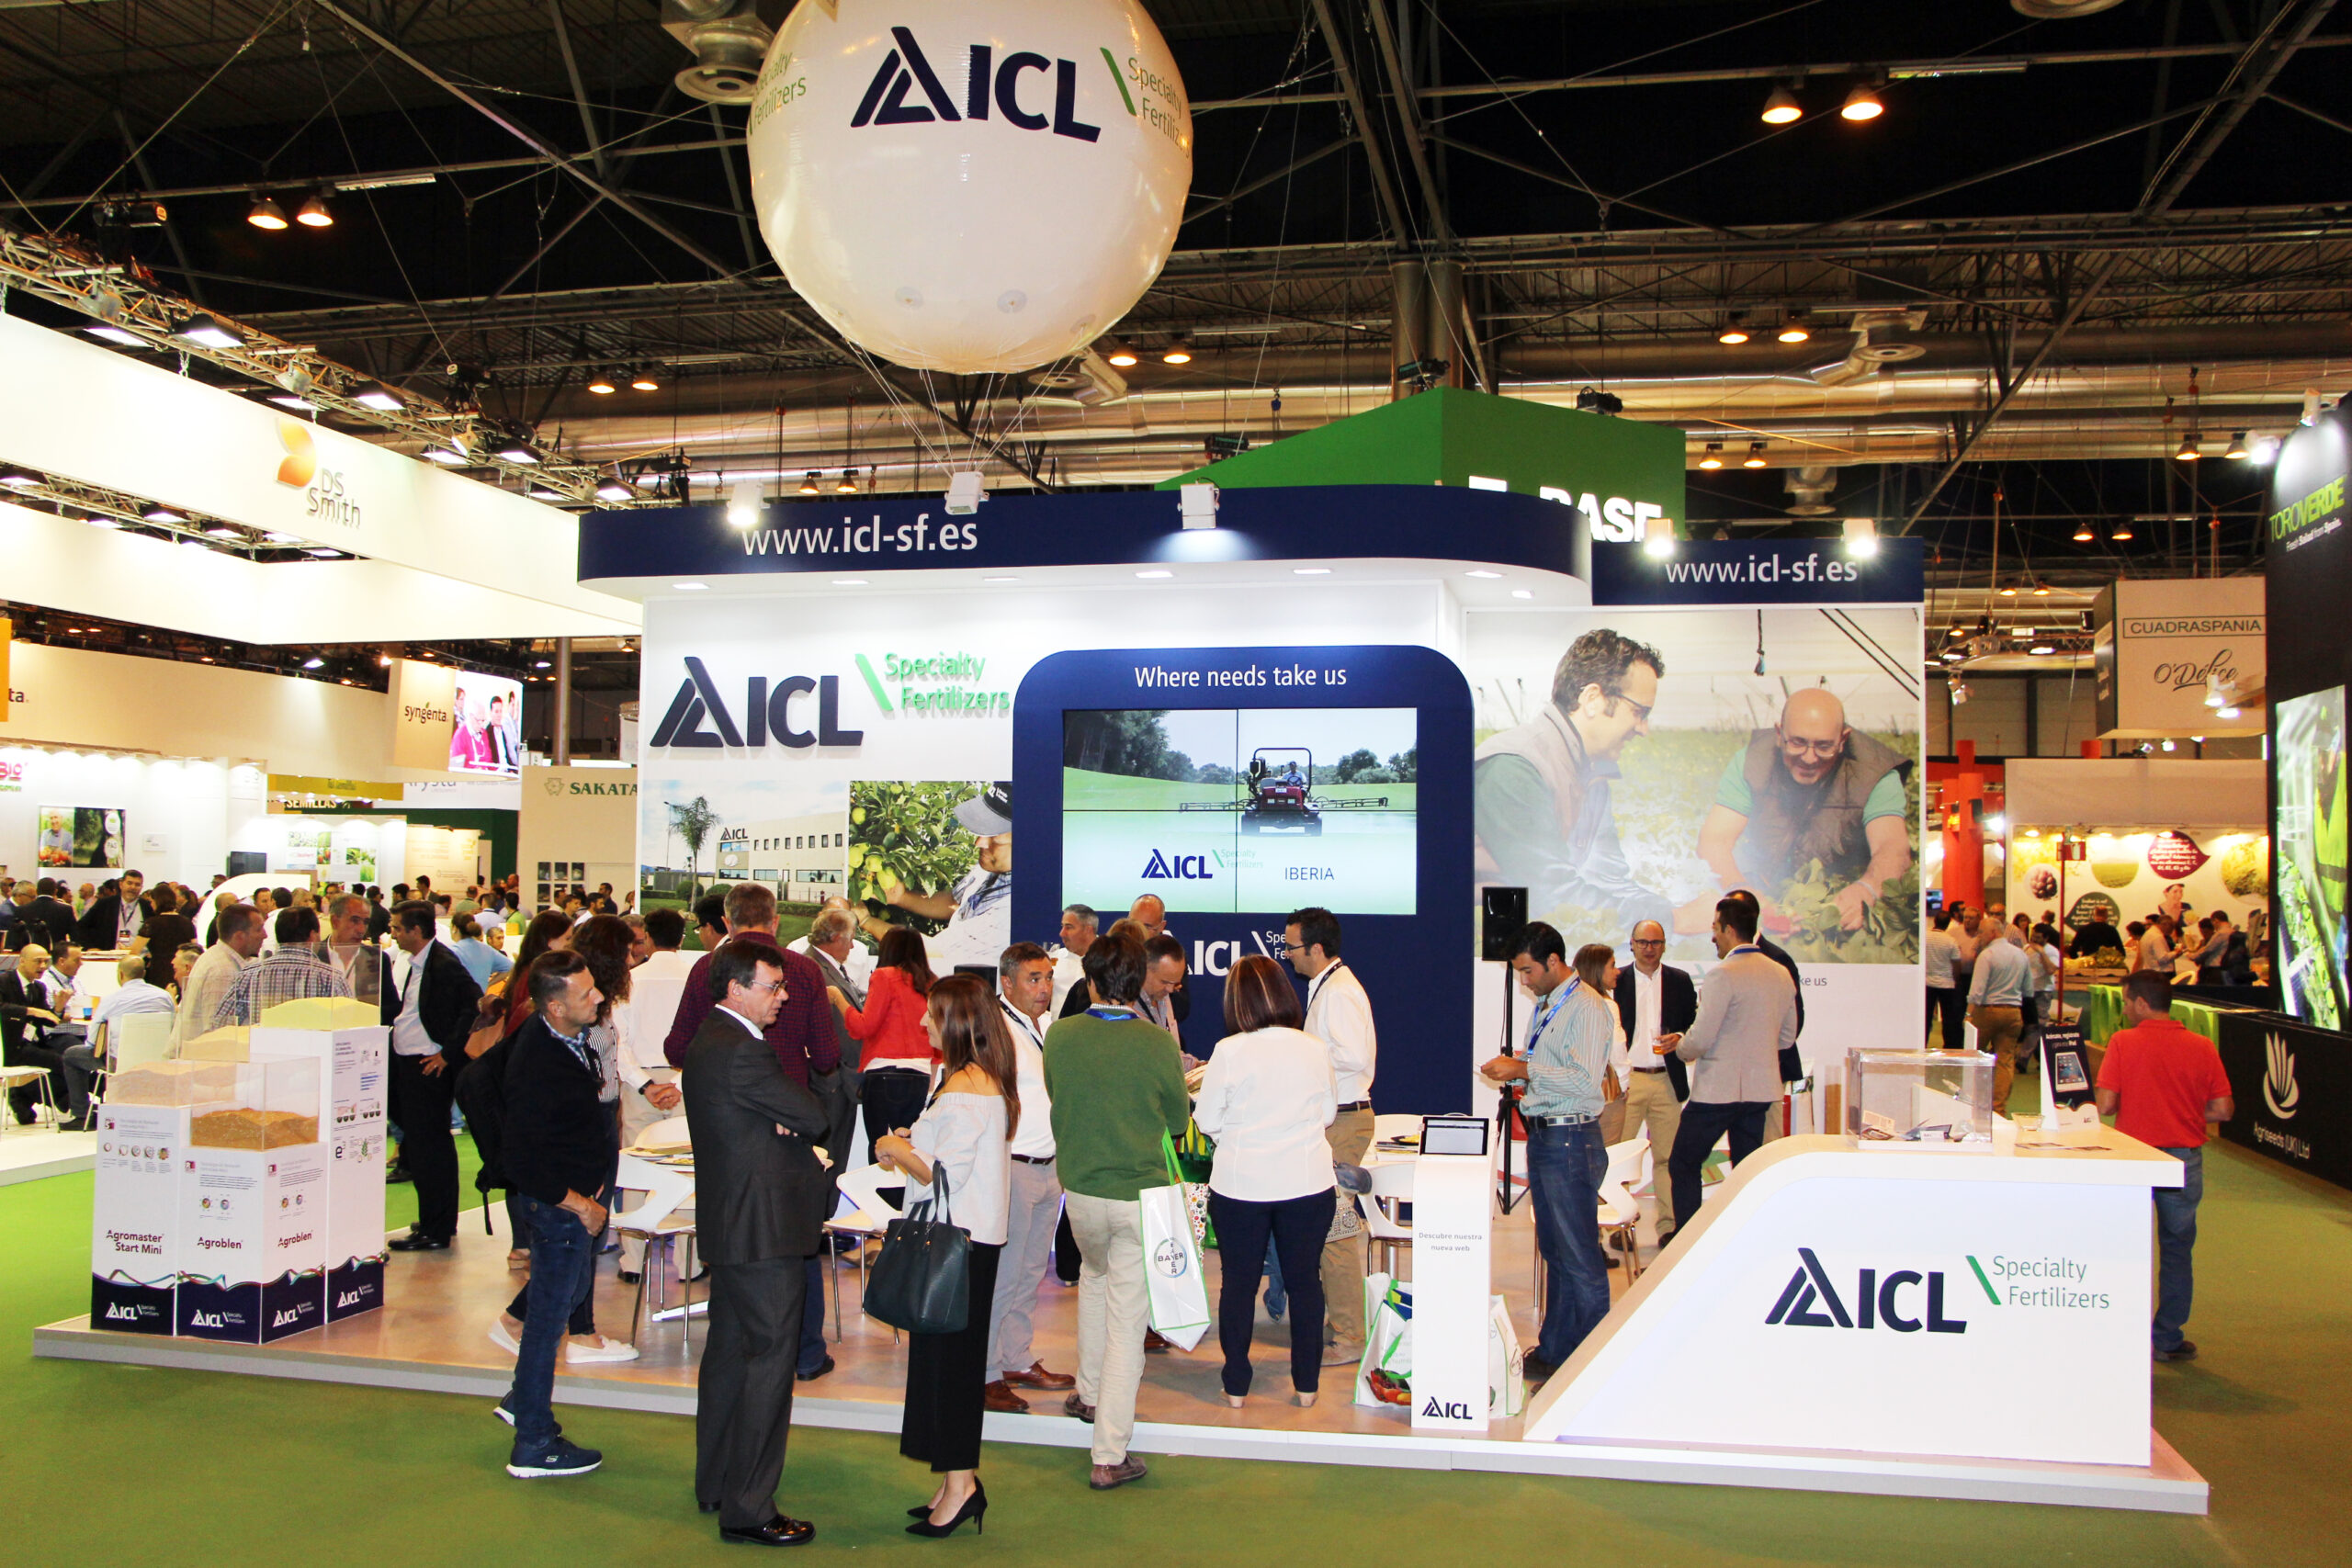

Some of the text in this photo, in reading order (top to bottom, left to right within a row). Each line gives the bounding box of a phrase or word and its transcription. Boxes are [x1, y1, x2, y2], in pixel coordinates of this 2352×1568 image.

[967, 44, 1101, 143] ICL
[1128, 57, 1182, 119] Specialty
[321, 468, 345, 497] DS
[308, 487, 361, 527] Smith
[2269, 474, 2346, 543] TOROVERDE
[741, 513, 978, 556] www.icl-sf.es
[1665, 553, 1859, 584] www.icl-sf.es
[2130, 619, 2262, 635] CUADRASPANIA
[884, 650, 987, 681] Specialty
[1135, 664, 1347, 689] Where needs take us
[899, 684, 1010, 712] Fertilizers
[404, 705, 447, 724] syngenta
[747, 674, 865, 750] ICL
[570, 782, 638, 796] SAKATA
[732, 828, 748, 840] ICL
[1220, 848, 1256, 859] Specialty
[1174, 855, 1213, 879] ICL
[1227, 860, 1264, 869] Fertilizers
[1284, 867, 1335, 881] IBERIA
[106, 1229, 163, 1243] Agromaster
[197, 1236, 242, 1249] Agroblen
[277, 1231, 312, 1248] Agroblen
[115, 1241, 163, 1255] Start Mini
[1158, 1252, 1184, 1262] BAYER
[1992, 1255, 2087, 1283] Specialty
[1858, 1269, 1967, 1334] ICL
[2008, 1286, 2109, 1310] Fertilizers
[119, 1305, 138, 1321] ICL
[206, 1314, 224, 1328] ICL
[1445, 1402, 1473, 1420] ICL
